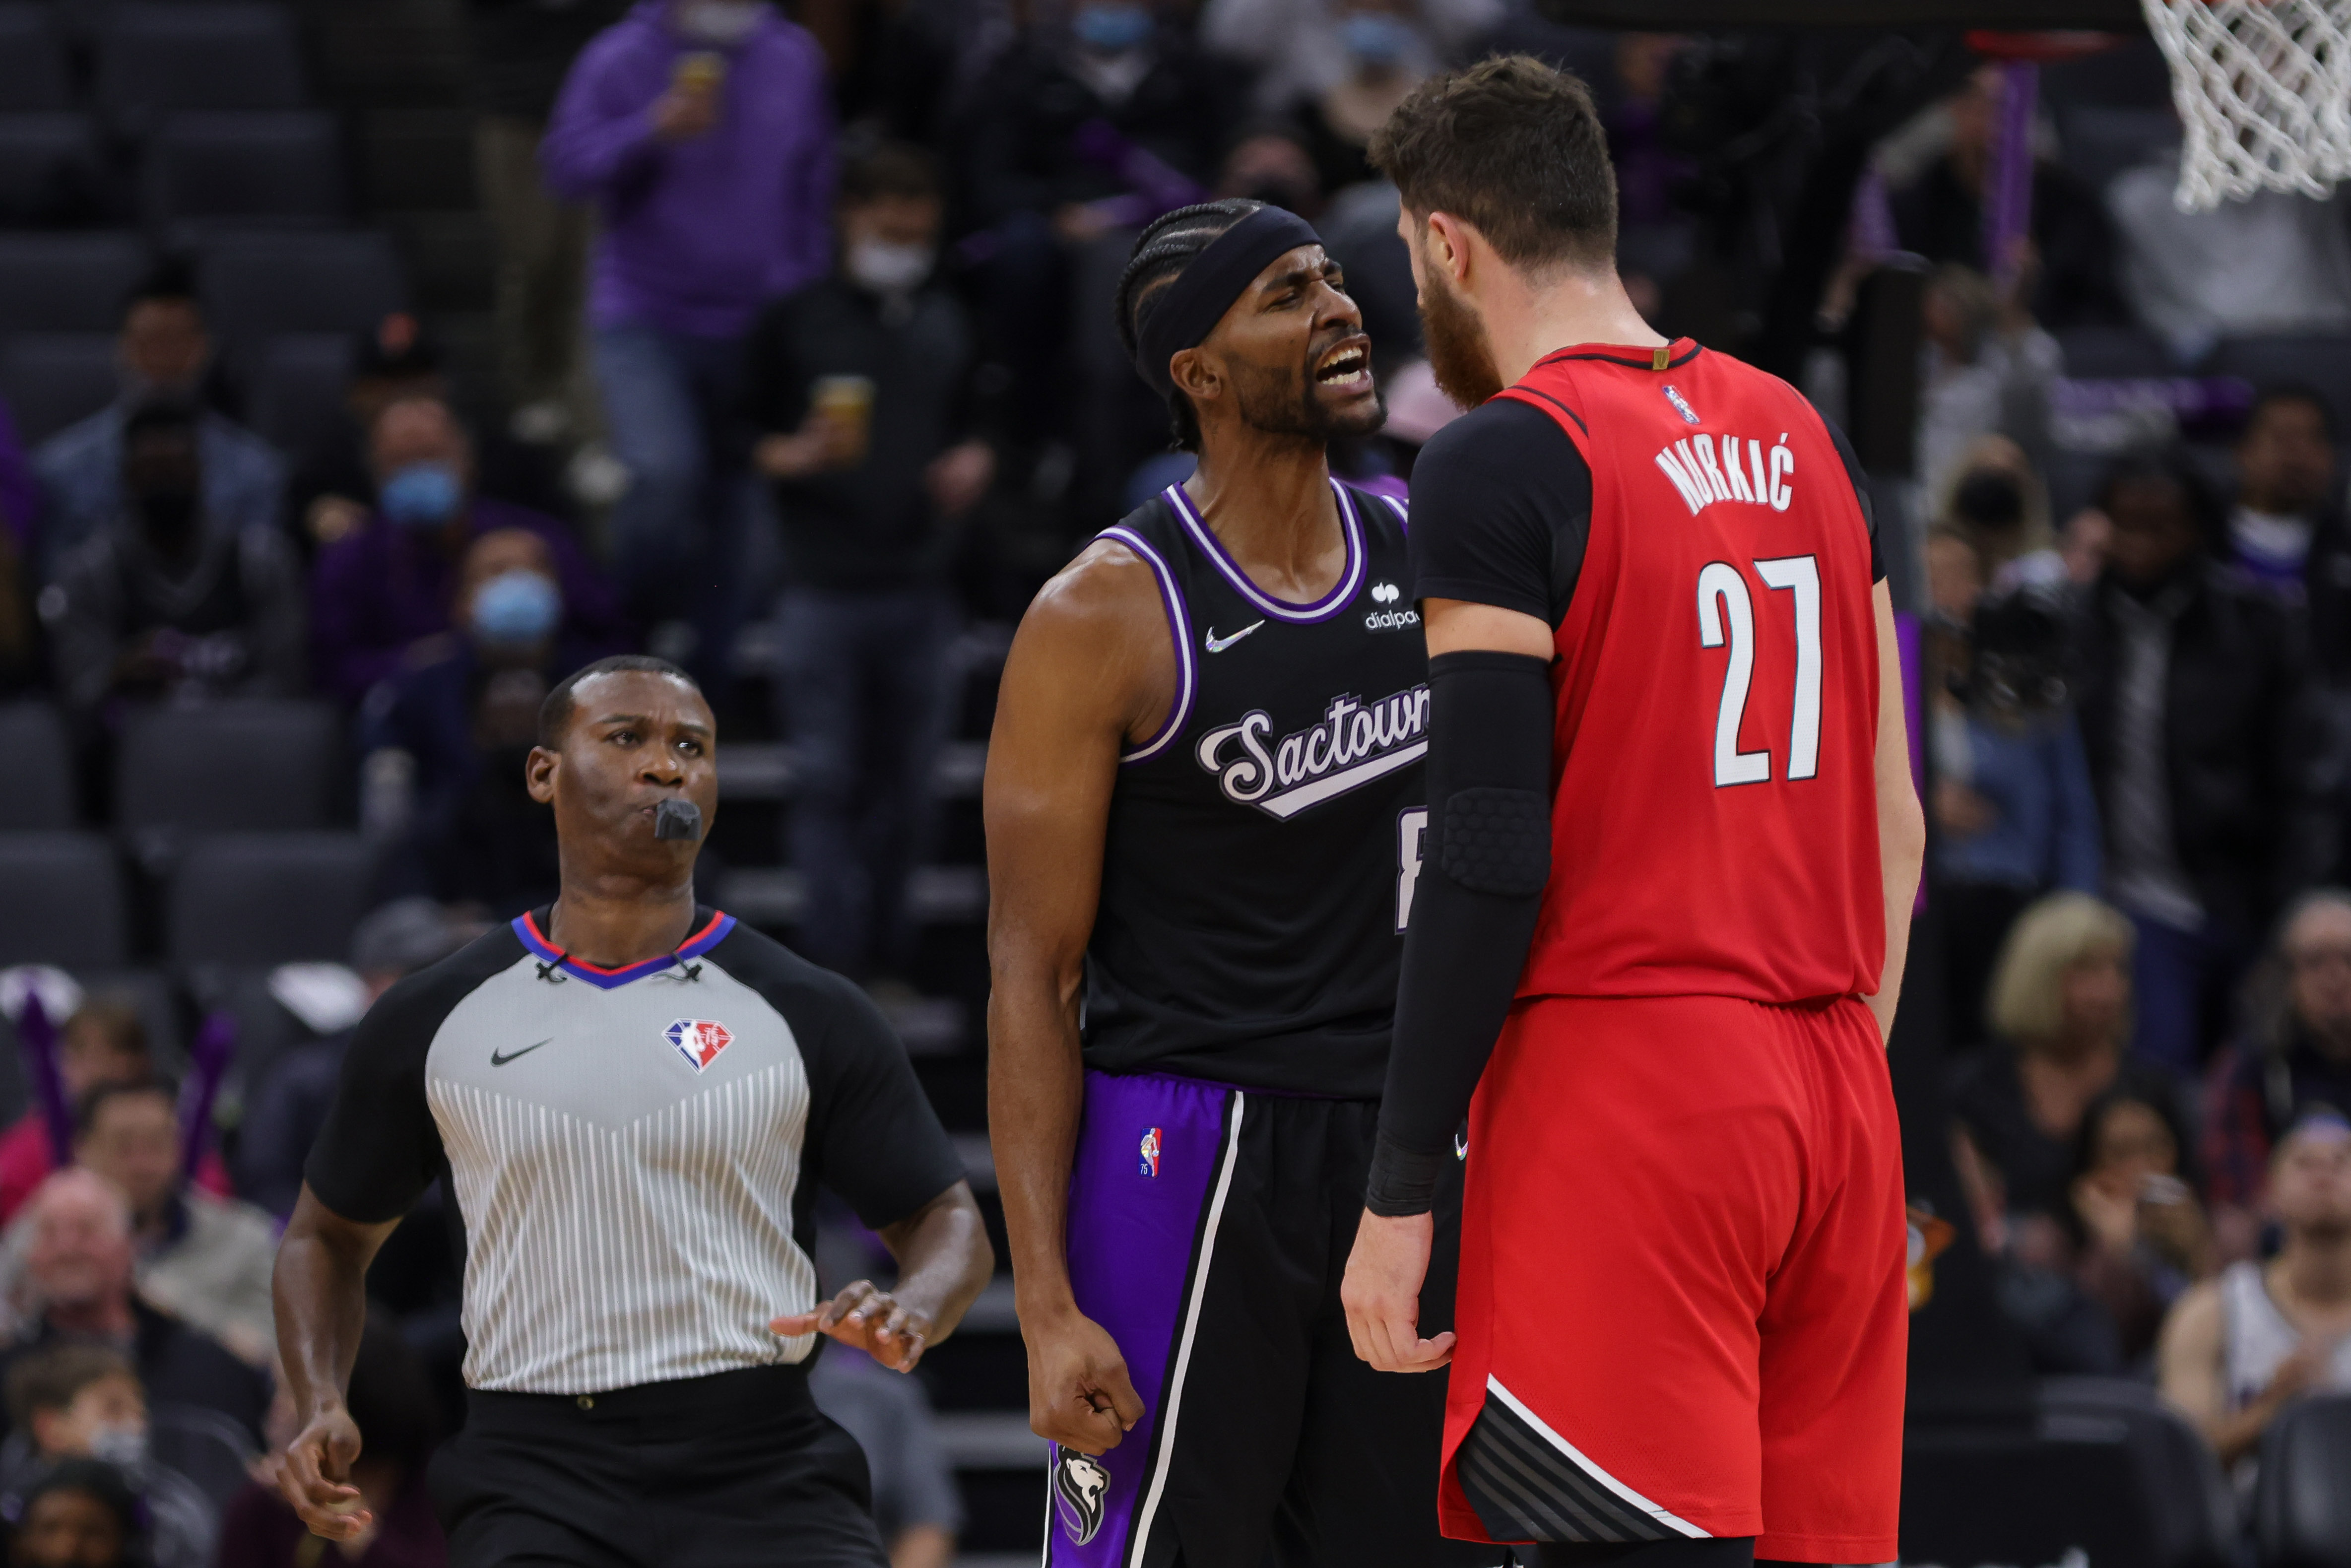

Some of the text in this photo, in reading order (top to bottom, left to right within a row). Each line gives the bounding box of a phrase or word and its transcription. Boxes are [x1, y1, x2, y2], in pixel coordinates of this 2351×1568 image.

[1655, 432, 1795, 517] NURKIĆ
[1365, 609, 1420, 630] dialpa
[1697, 553, 1823, 788] 27
[1140, 1164, 1148, 1175] 75
